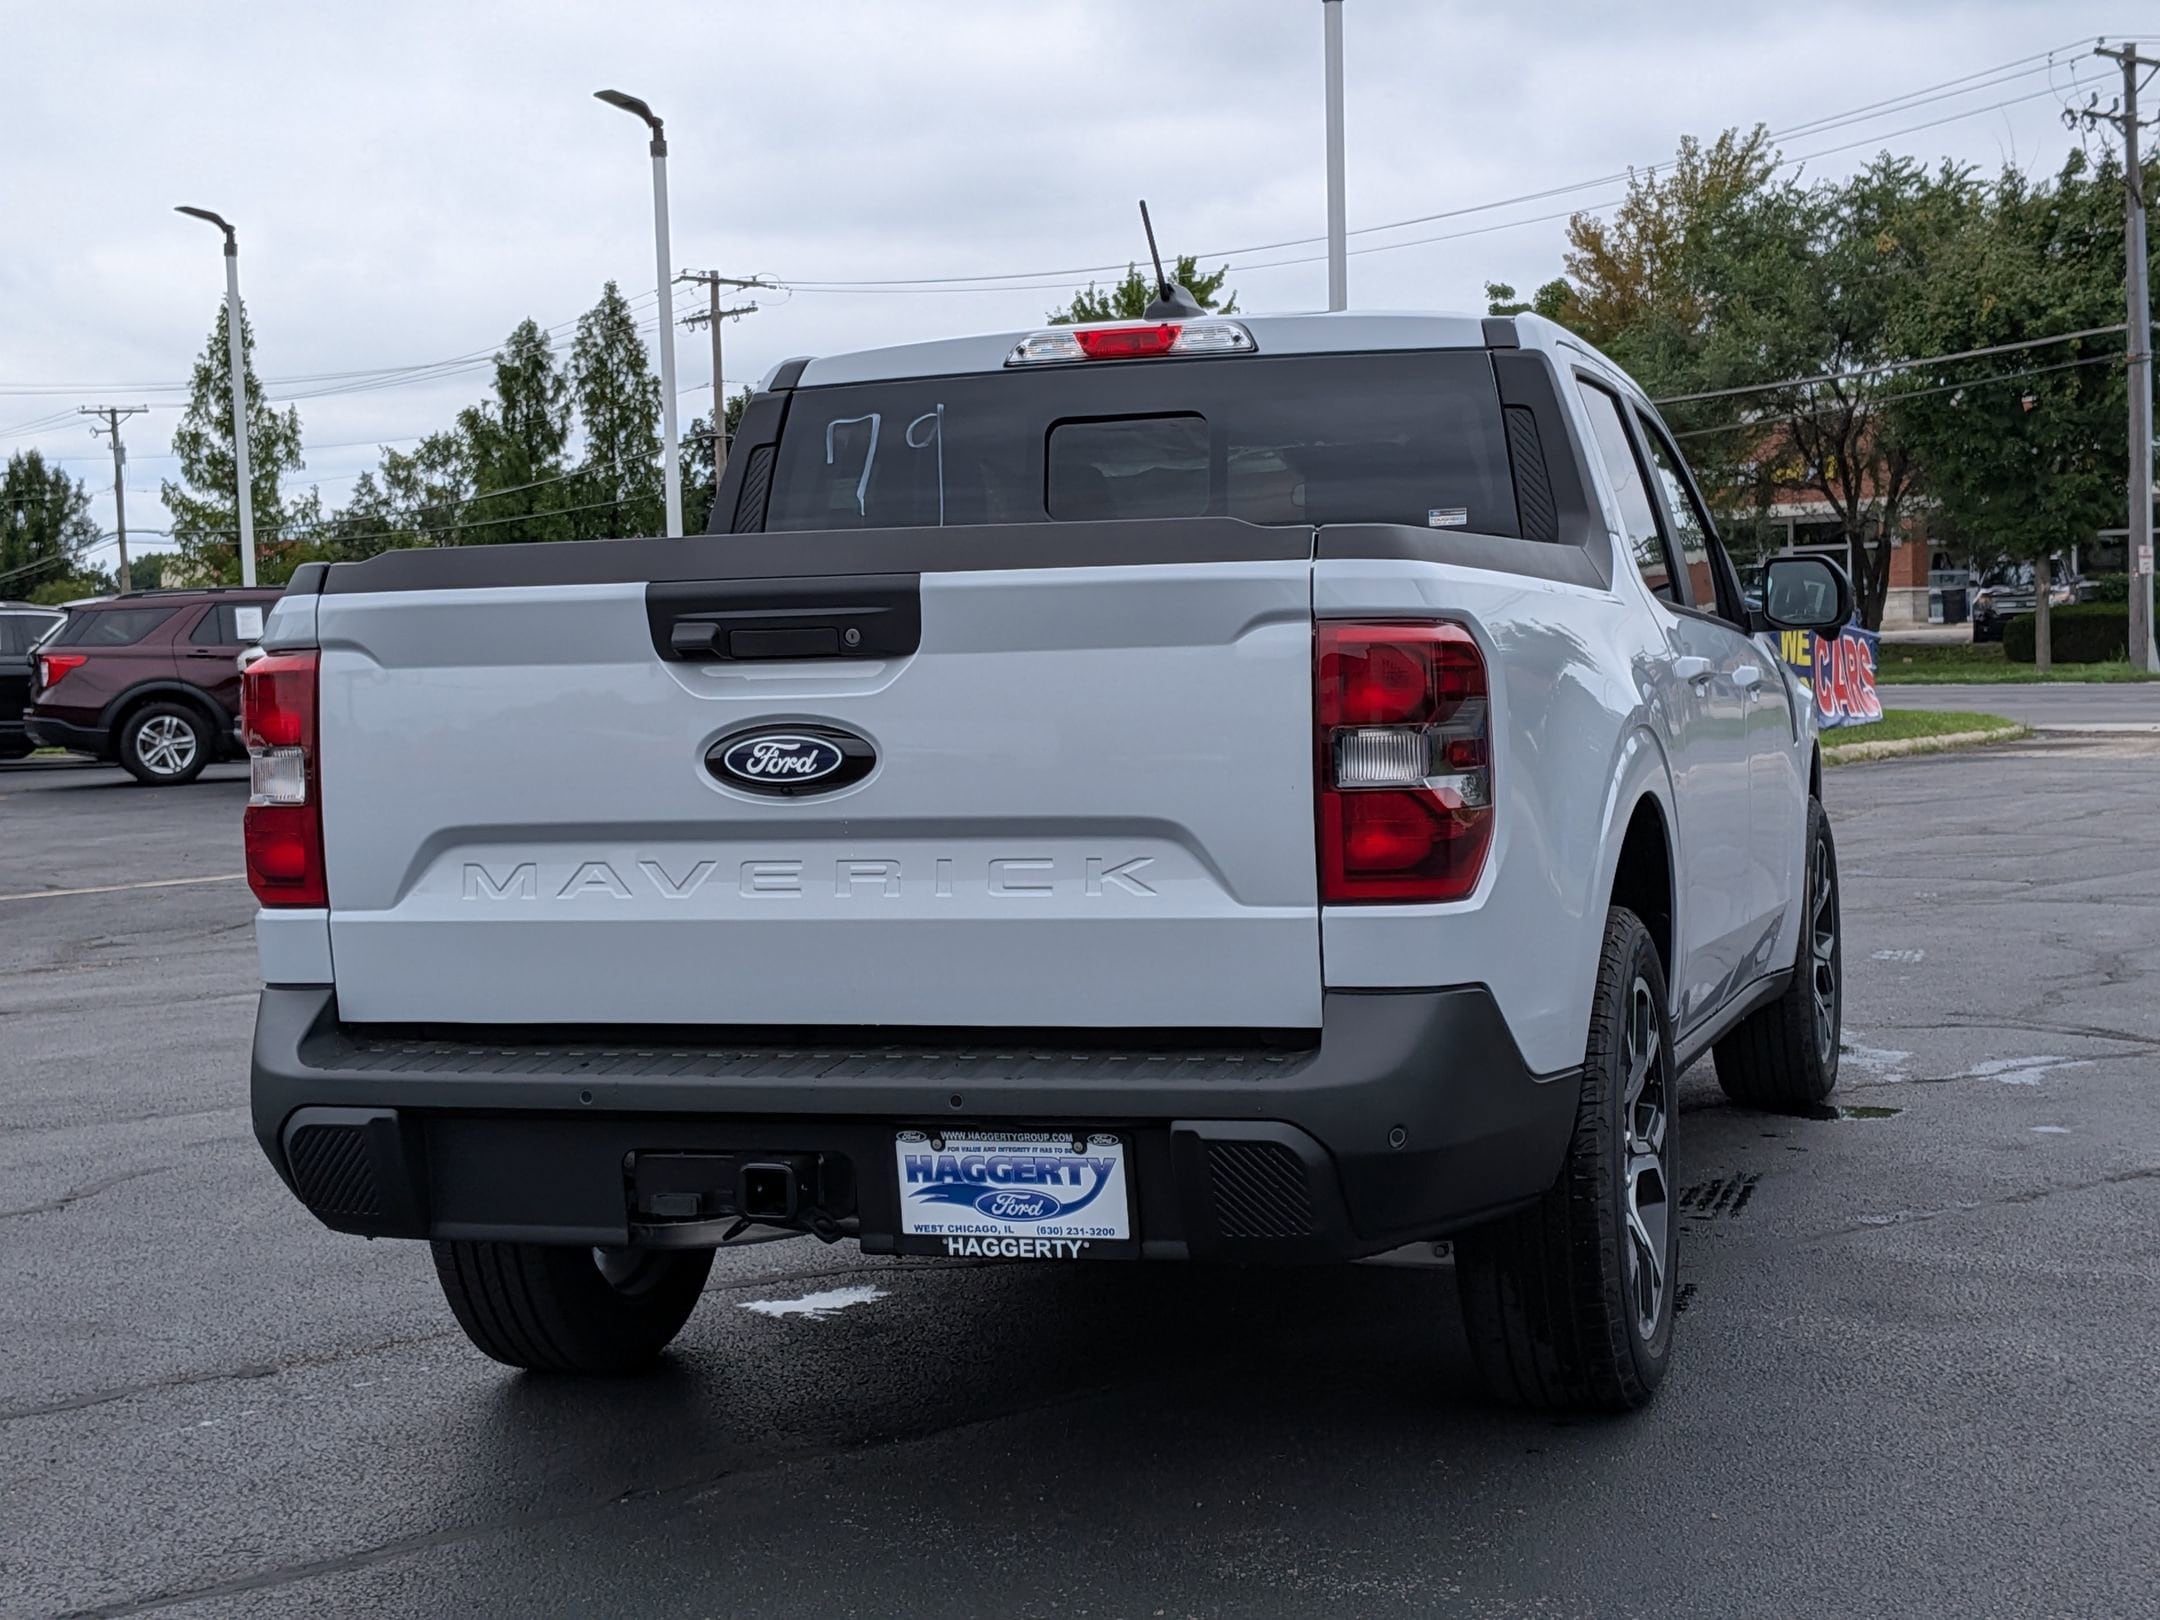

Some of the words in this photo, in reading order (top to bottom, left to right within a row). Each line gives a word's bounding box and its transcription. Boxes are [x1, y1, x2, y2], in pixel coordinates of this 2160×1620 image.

[1781, 630, 1811, 666] WE
[1814, 633, 1882, 718] CARS
[746, 741, 819, 774] Ford
[462, 857, 1158, 900] MAVERICK
[940, 1131, 1073, 1143] WWW.HAGGERTYGROUP.COM
[904, 1154, 1117, 1186] HAGGERTY
[991, 1194, 1043, 1217] Ford
[913, 1224, 944, 1233] WEST
[947, 1224, 1001, 1234] CHICAGO,
[1003, 1225, 1015, 1234] IL
[1036, 1227, 1063, 1236] (630)
[1066, 1227, 1115, 1237] 231-3200
[948, 1236, 1083, 1259] HAGGERTY
